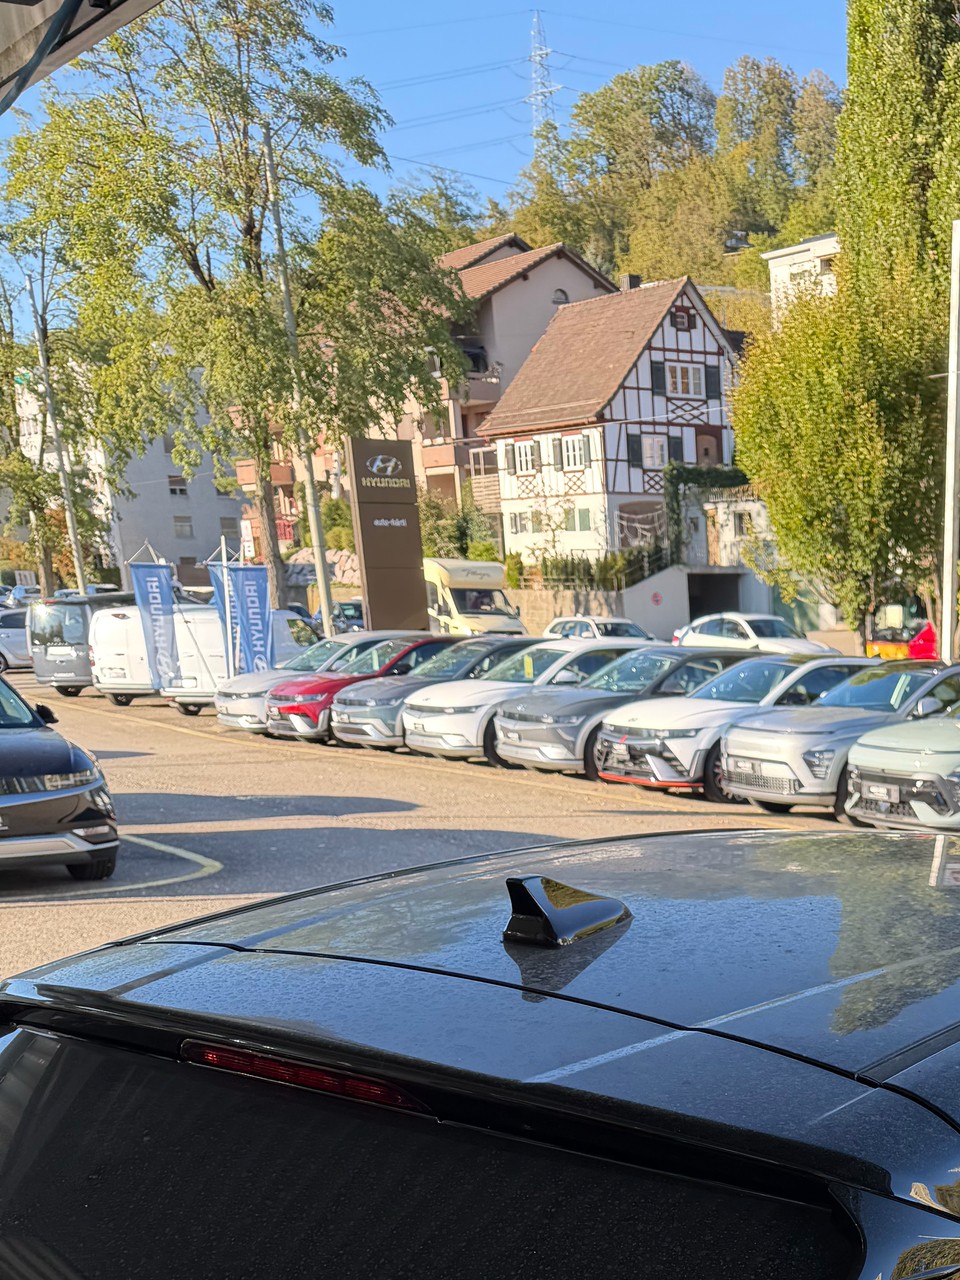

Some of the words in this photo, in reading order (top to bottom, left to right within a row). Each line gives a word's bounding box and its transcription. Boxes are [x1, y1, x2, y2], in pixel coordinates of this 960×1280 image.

[361, 477, 411, 489] HYUNDAI
[145, 577, 168, 648] HYUNDAI
[244, 580, 265, 652] HYUNDAI
